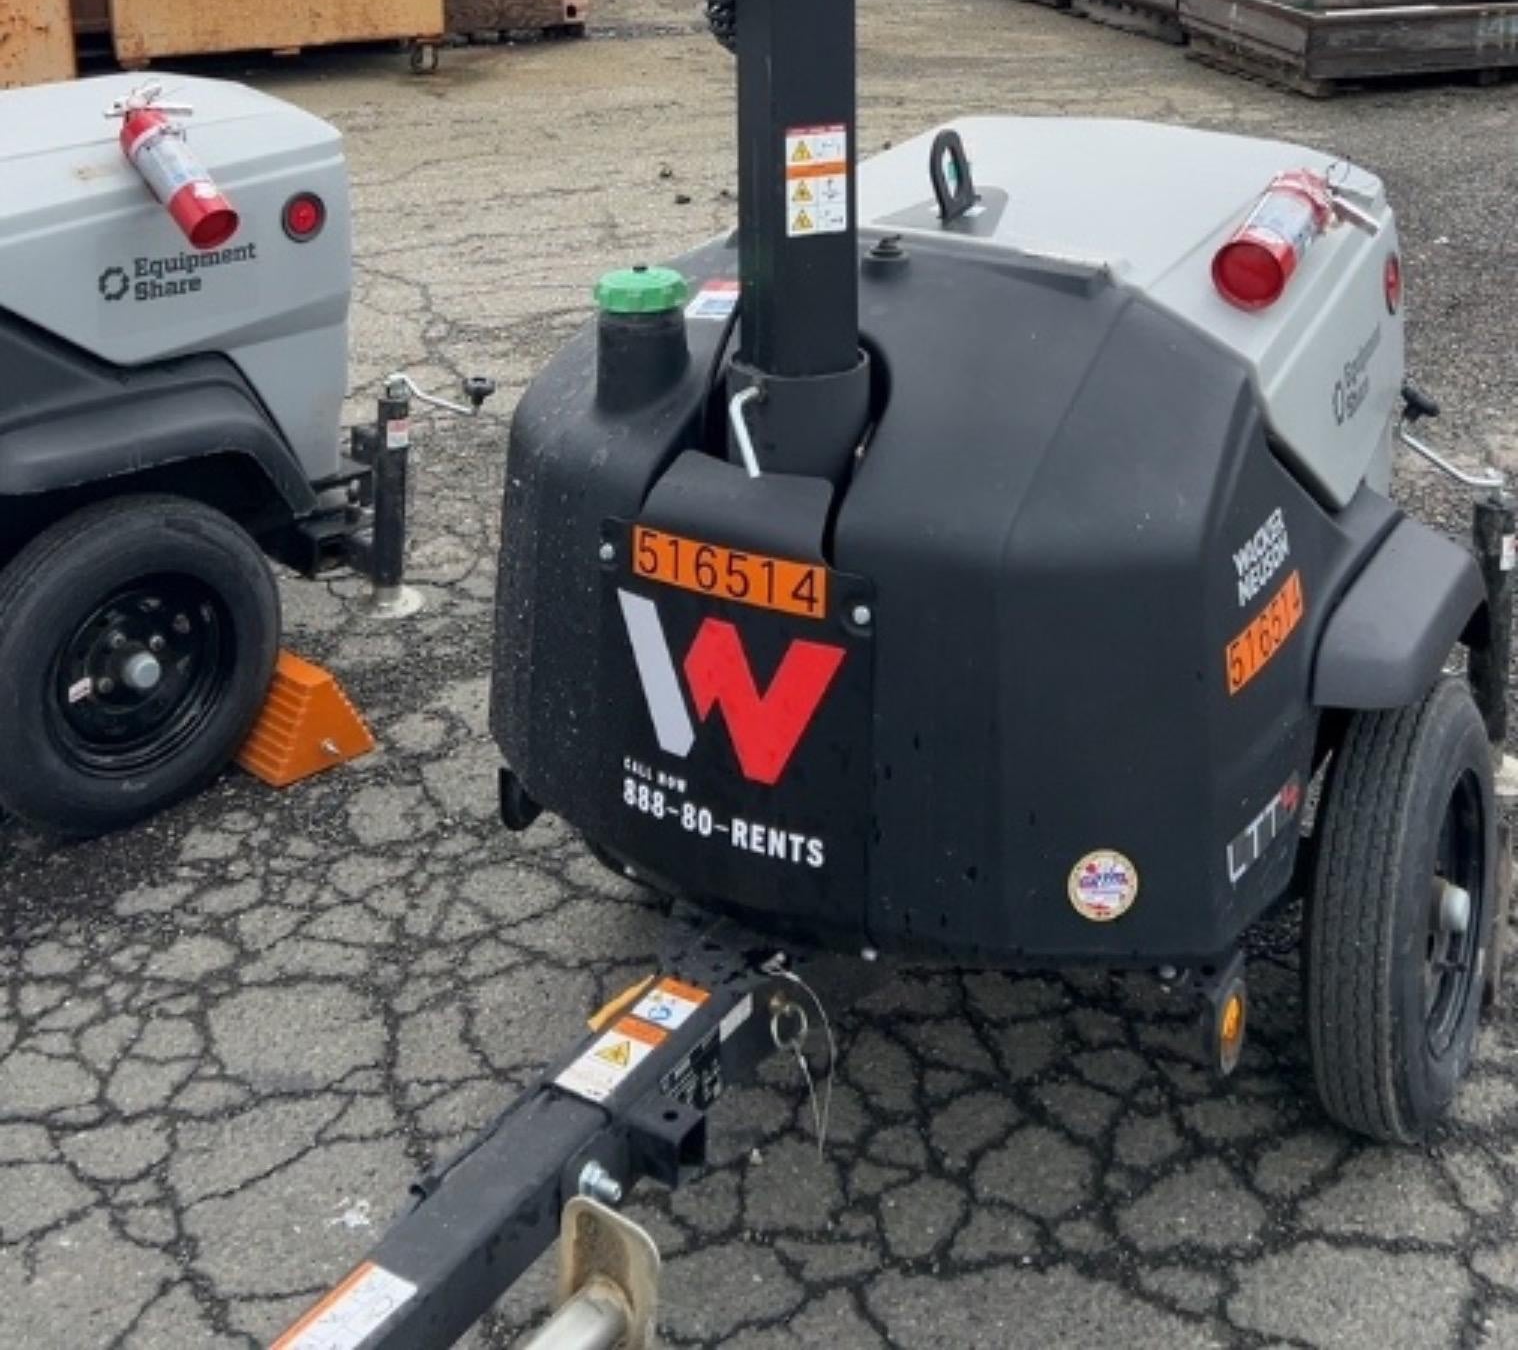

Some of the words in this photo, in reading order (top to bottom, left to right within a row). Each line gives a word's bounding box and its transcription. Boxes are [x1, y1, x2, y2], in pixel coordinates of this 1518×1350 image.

[133, 242, 256, 280] Equipment
[134, 275, 202, 301] Share
[638, 530, 819, 613] 516514
[1229, 572, 1301, 686] 516514
[623, 776, 825, 868] 888-80-RENTS
